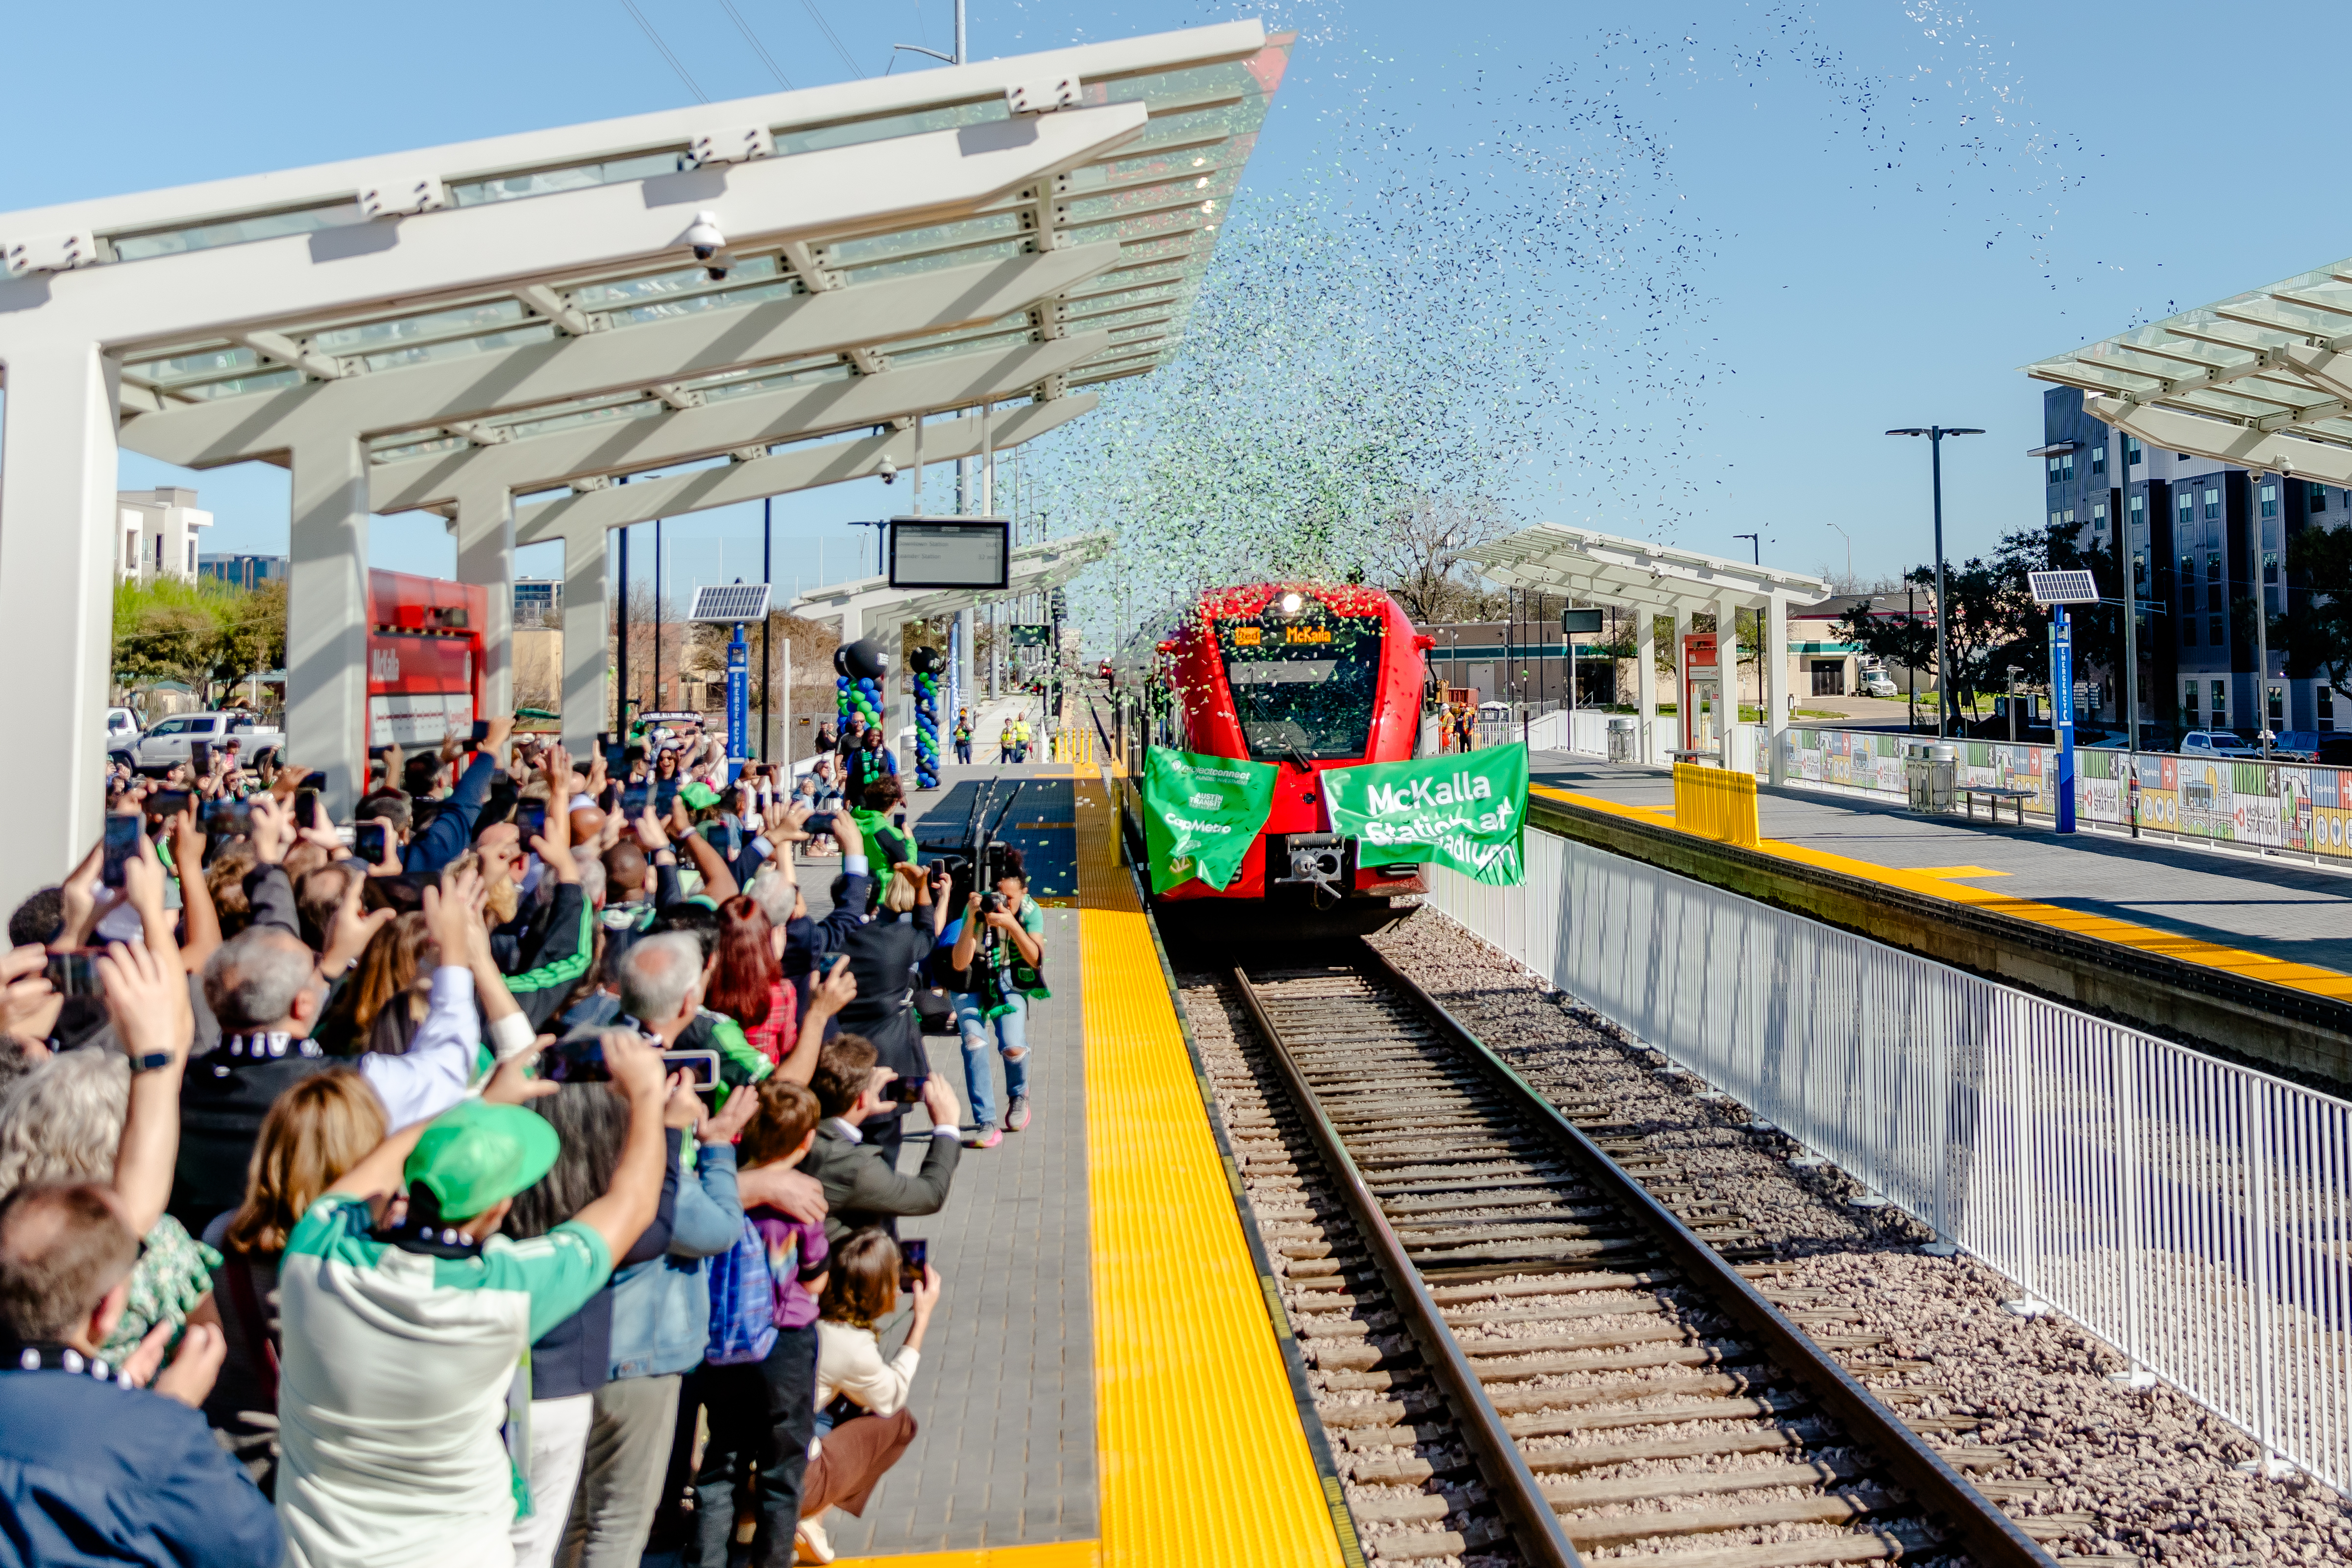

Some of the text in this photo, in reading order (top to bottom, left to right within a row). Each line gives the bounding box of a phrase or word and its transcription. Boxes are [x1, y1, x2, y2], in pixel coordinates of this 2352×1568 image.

[1189, 796, 1222, 807] TRANSIT
[1195, 792, 1224, 801] AUSTIN
[1368, 771, 1492, 817] McKalla
[1165, 812, 1231, 834] CapMetro
[1479, 796, 1515, 831] at
